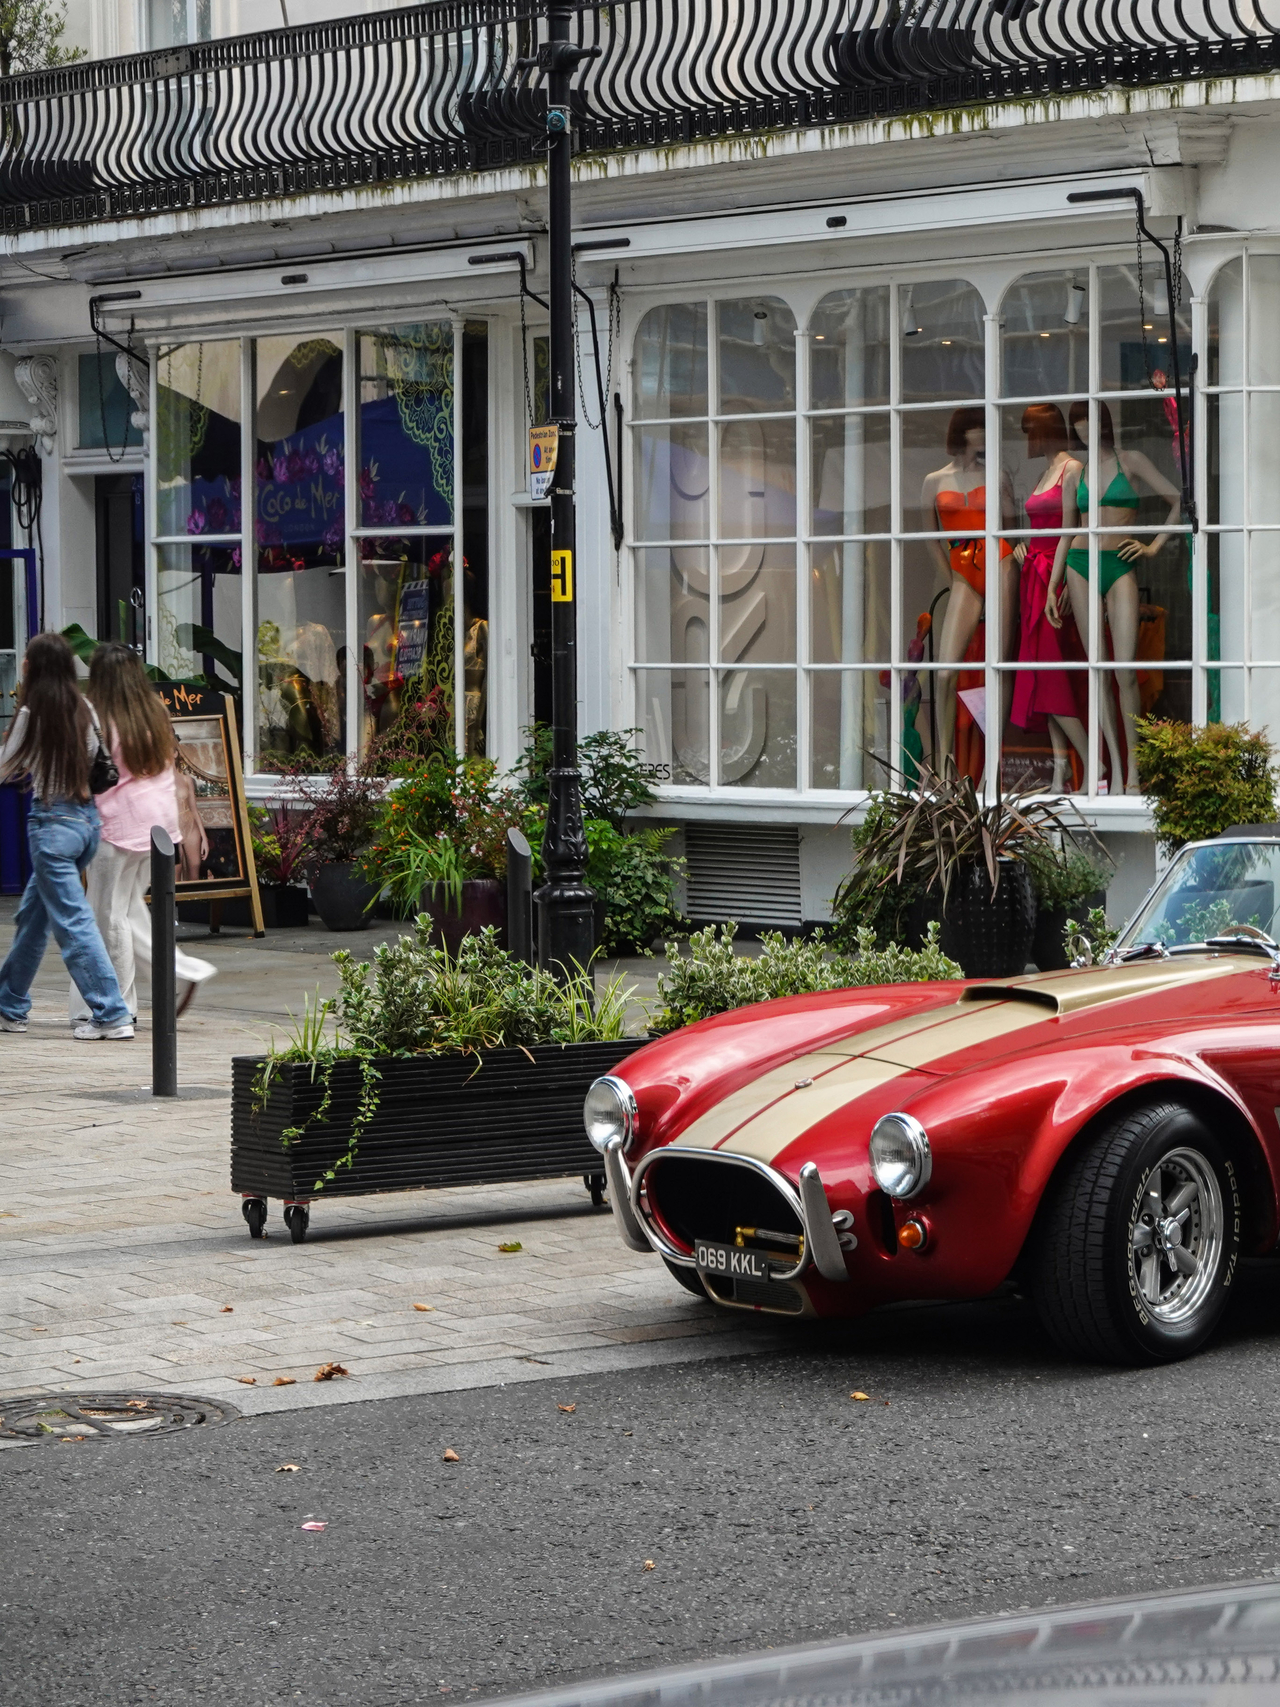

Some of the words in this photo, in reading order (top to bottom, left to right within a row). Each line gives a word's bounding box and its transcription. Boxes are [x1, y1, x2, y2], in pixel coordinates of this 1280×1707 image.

[261, 484, 291, 522] Coco
[310, 474, 339, 520] Mer
[173, 684, 203, 711] Mer
[1224, 1160, 1241, 1242] Radial
[730, 1251, 762, 1277] KKL
[1127, 1167, 1150, 1326] BFGoodrich
